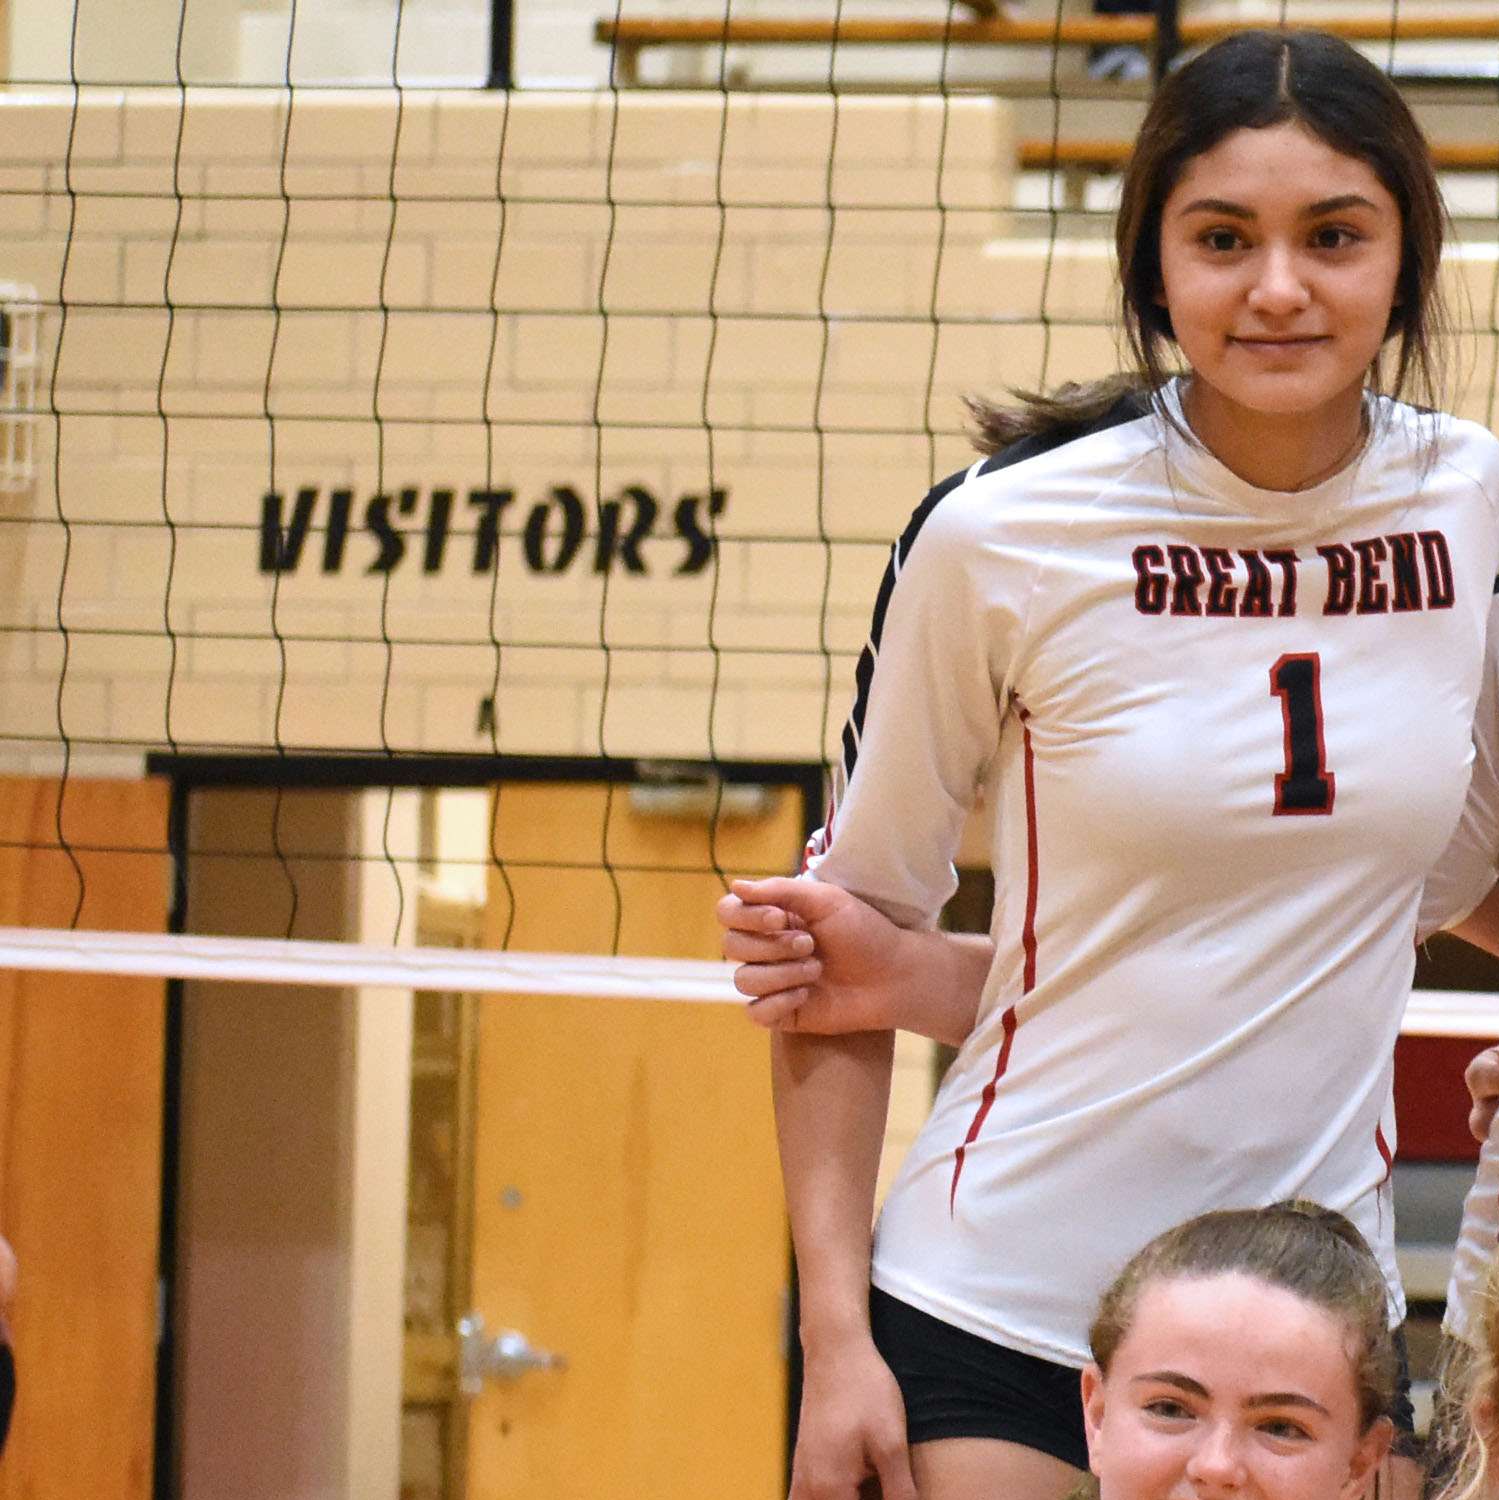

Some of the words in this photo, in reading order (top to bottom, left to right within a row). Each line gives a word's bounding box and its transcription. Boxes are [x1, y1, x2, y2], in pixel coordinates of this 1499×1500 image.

[259, 486, 728, 575] VISITORS
[1132, 543, 1302, 617] GREAT
[1315, 529, 1455, 616] BEND
[1269, 651, 1336, 816] 1
